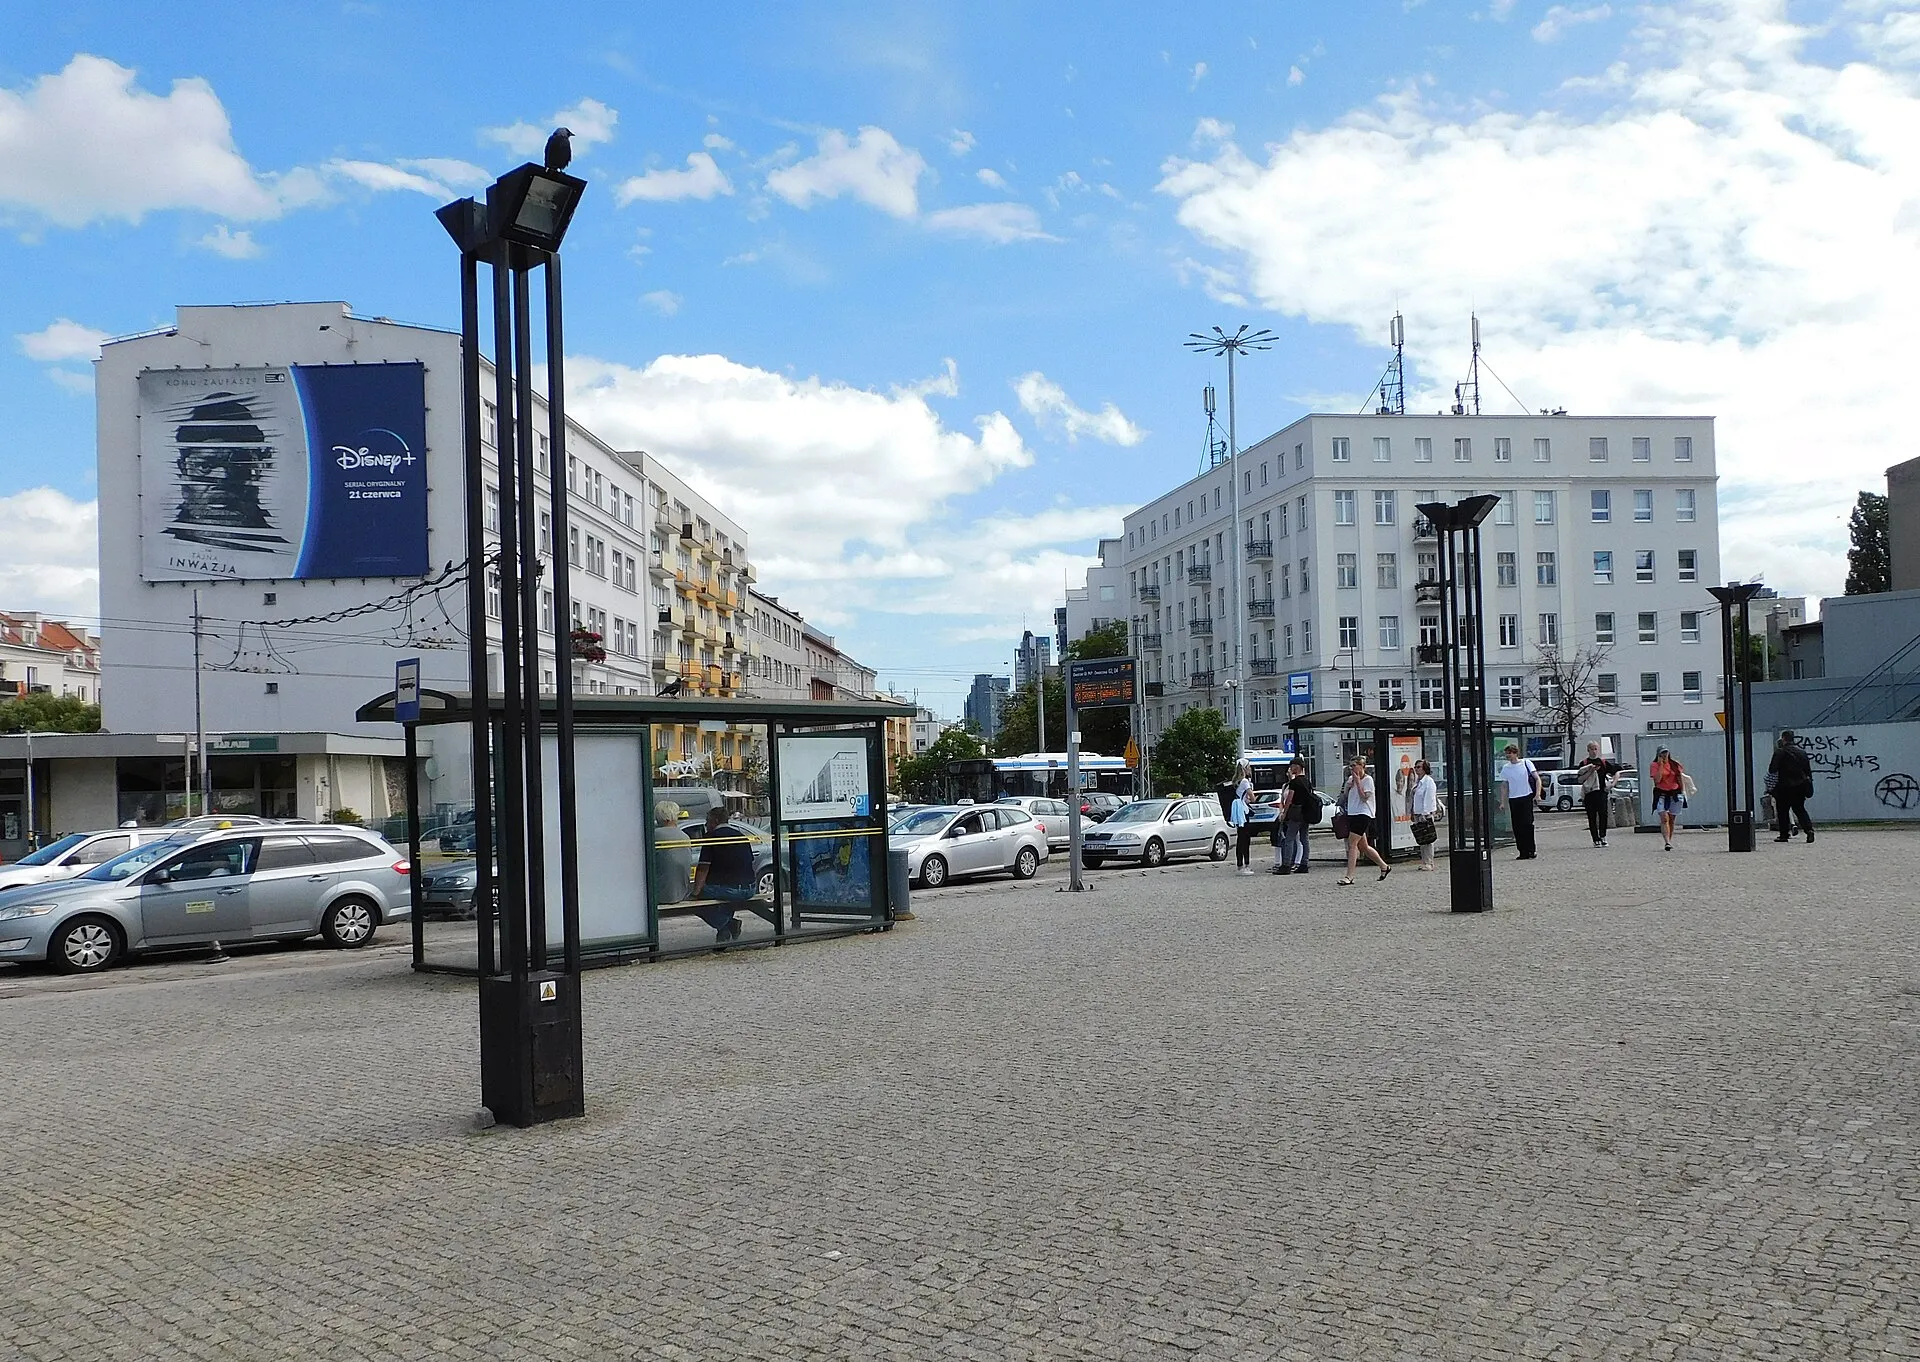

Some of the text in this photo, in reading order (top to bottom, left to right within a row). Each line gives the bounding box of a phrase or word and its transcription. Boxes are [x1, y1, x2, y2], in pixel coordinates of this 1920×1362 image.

[166, 378, 197, 387] KOMU
[366, 480, 406, 488] ORYGINALNY
[349, 490, 402, 499] 21 czerwca
[169, 556, 237, 574] INWAZJA
